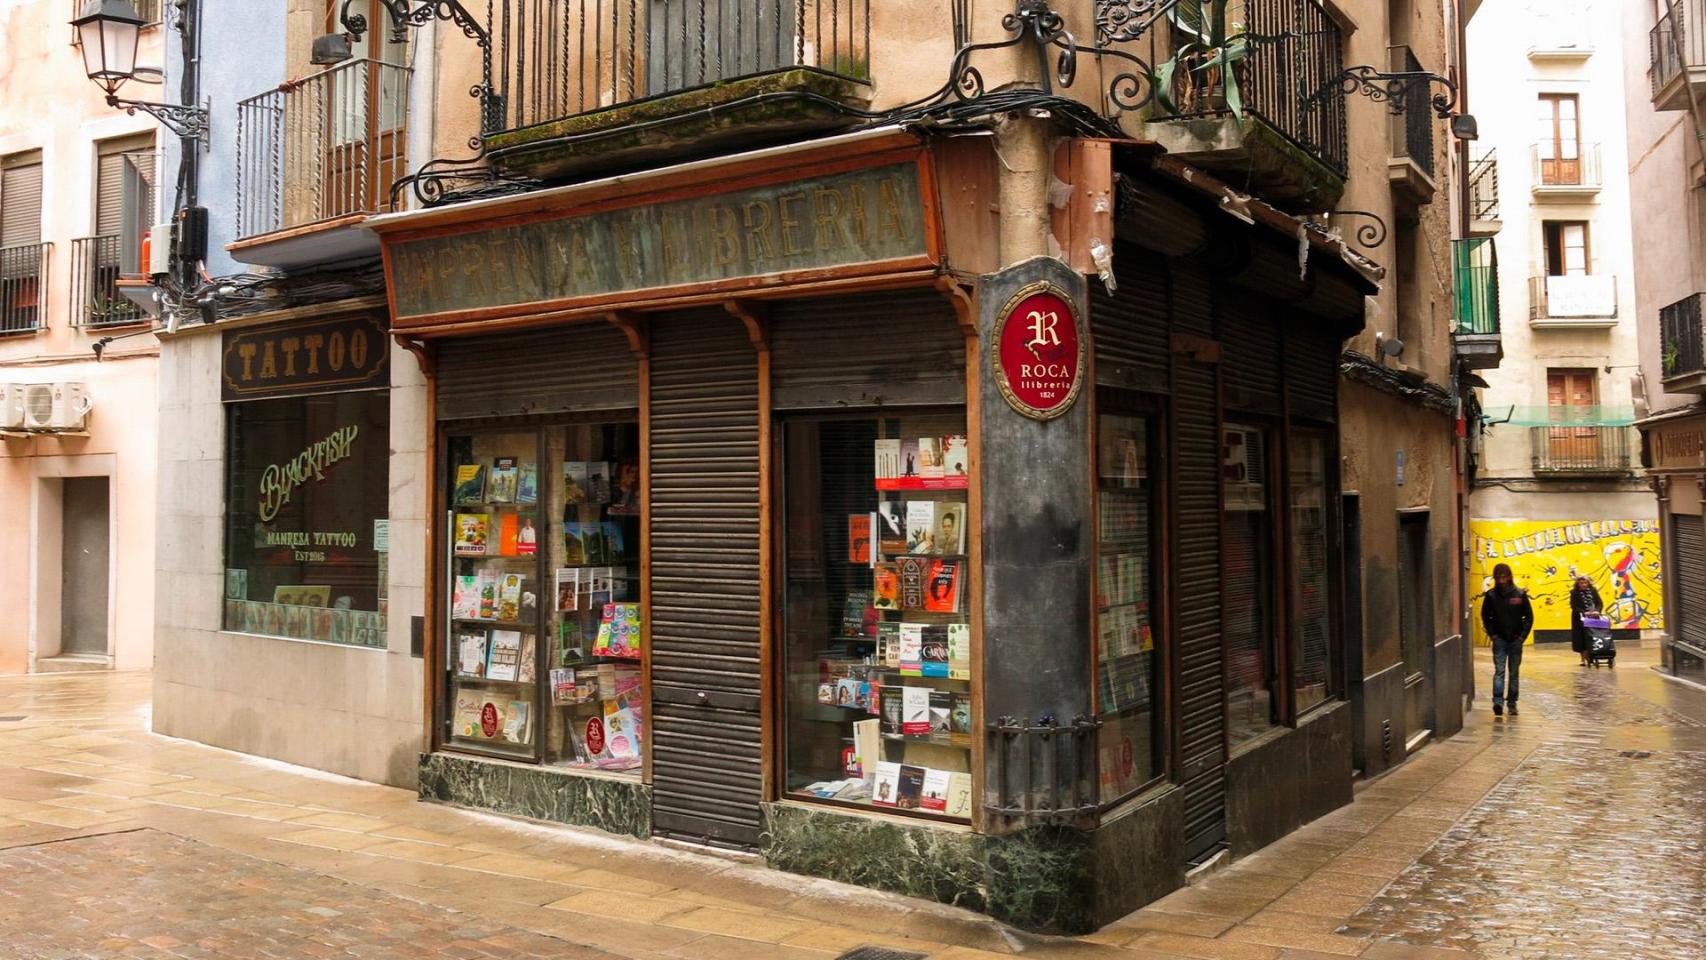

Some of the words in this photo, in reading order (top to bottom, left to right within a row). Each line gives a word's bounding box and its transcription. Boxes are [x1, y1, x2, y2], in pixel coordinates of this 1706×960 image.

[660, 178, 907, 278] LIBRERIA
[239, 329, 368, 380] TATTOO
[1021, 364, 1070, 378] ROCA
[1021, 381, 1071, 389] llibreria
[259, 424, 359, 522] BLACKFISH
[266, 532, 310, 549] MANRESA
[312, 532, 357, 548] TATTOO
